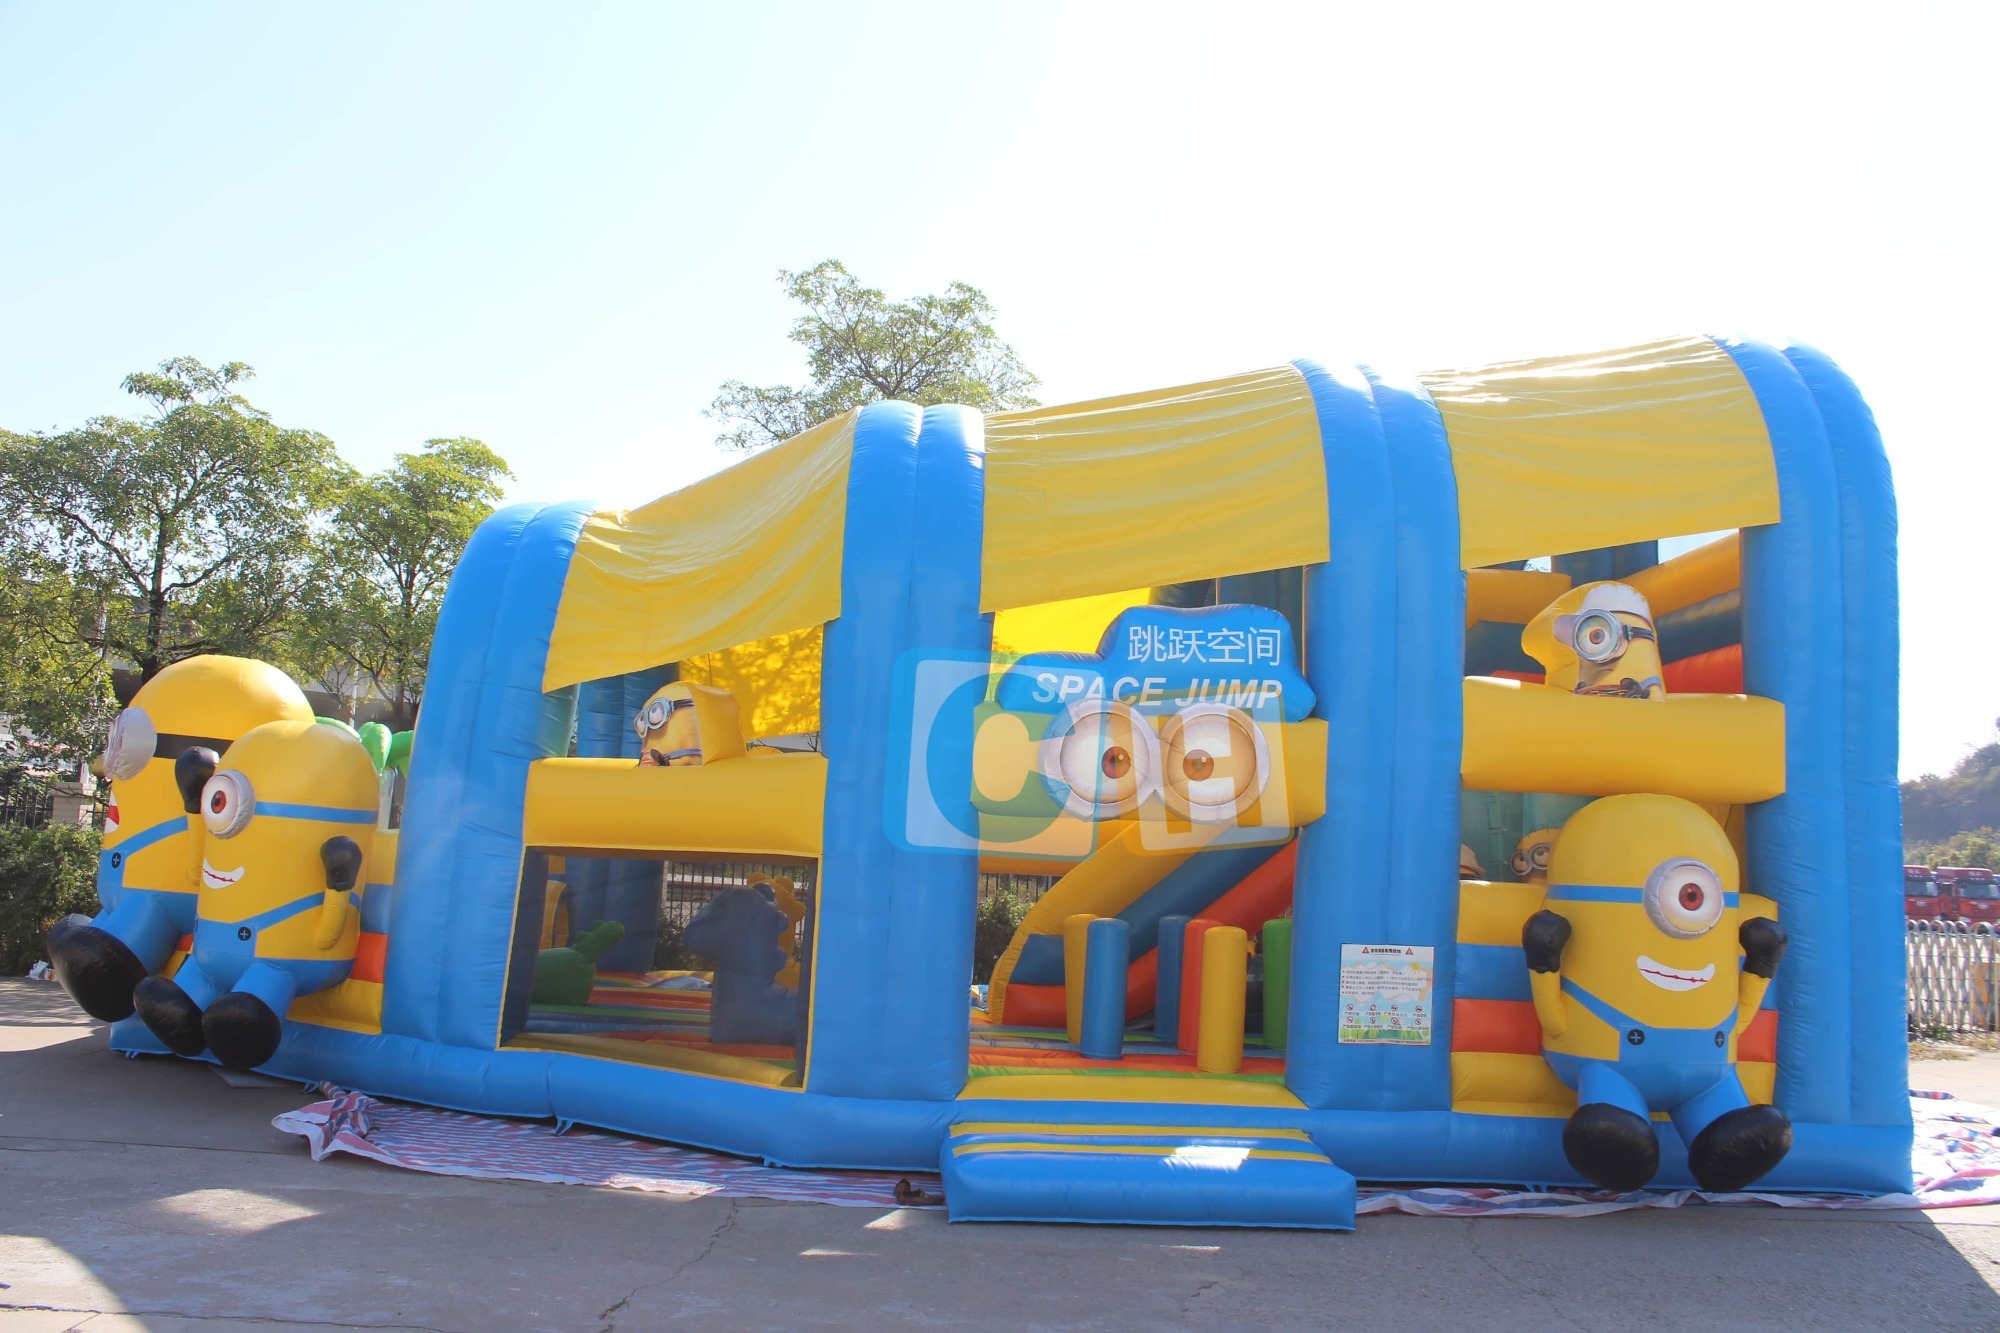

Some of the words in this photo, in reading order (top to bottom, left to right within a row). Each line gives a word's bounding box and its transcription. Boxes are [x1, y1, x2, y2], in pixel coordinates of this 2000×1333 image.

[1127, 625, 1282, 666] 跳跃空间
[1032, 673, 1167, 706] SPACE
[1175, 678, 1283, 709] JUMP
